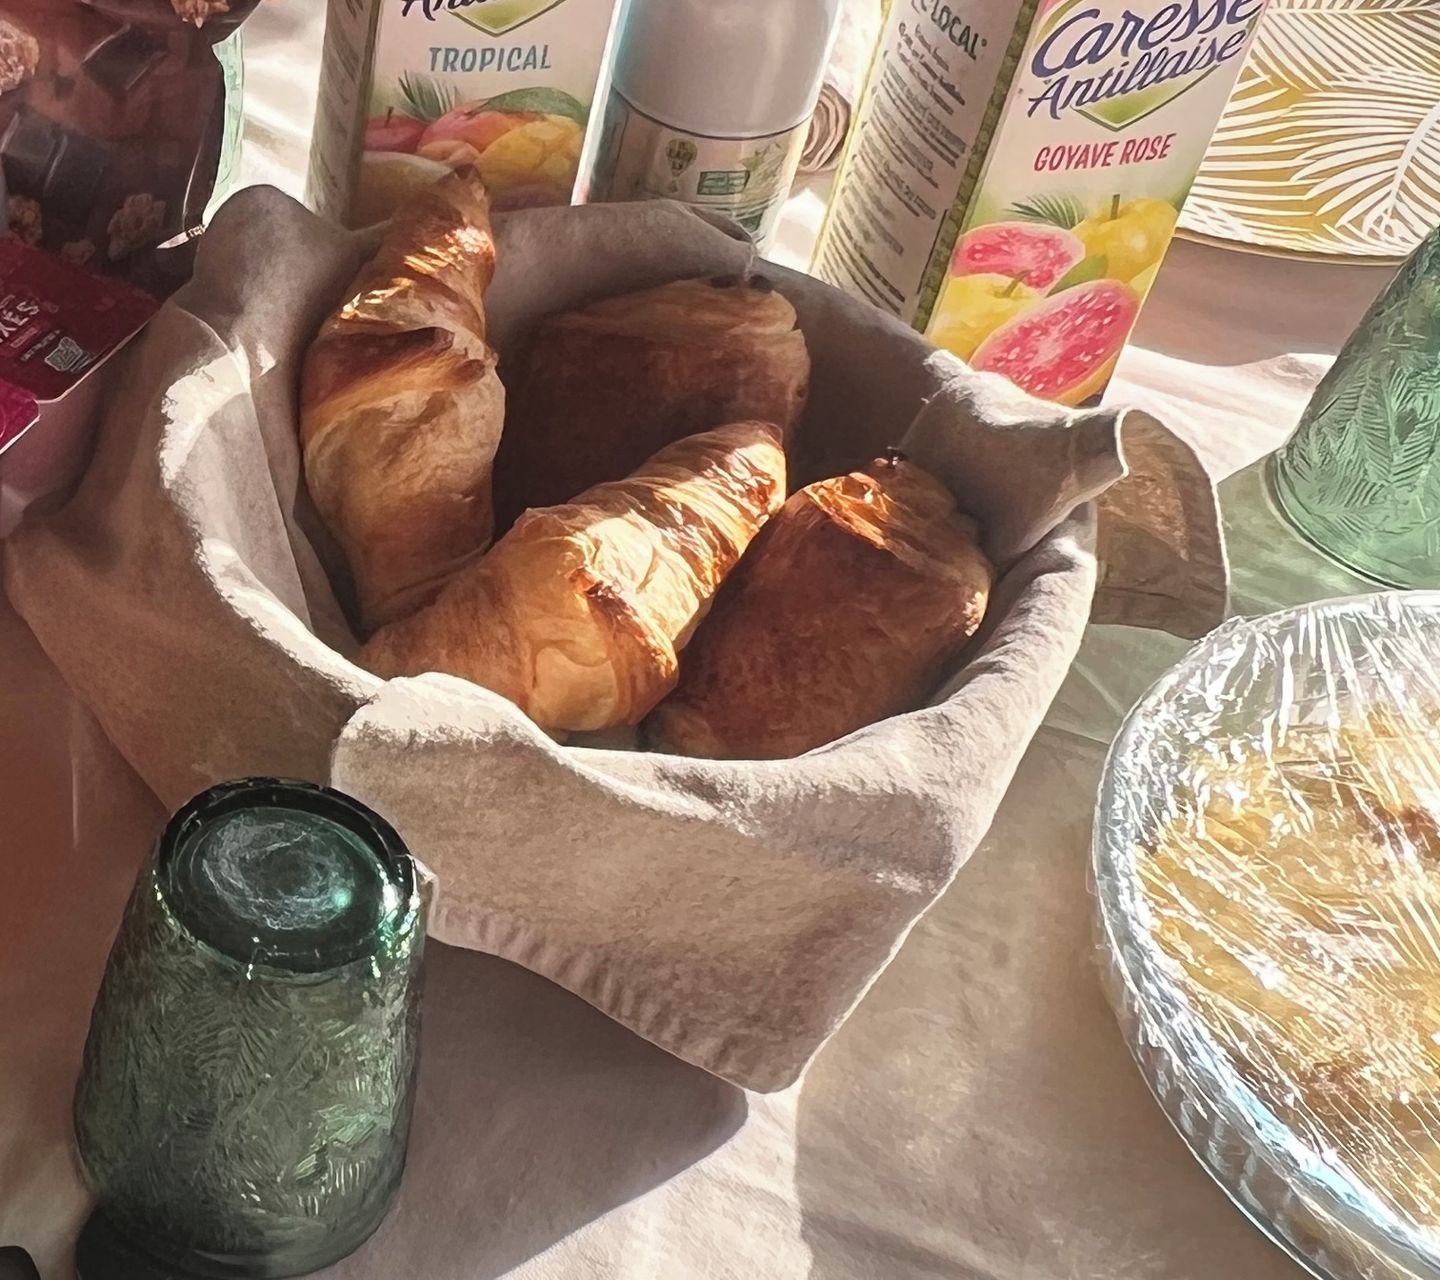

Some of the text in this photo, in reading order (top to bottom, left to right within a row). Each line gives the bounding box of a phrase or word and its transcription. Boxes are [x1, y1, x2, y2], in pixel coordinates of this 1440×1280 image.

[429, 44, 552, 73] TROPICAL
[1026, 29, 1247, 121] Antillaise
[1033, 132, 1178, 172] GOYAVE ROSE
